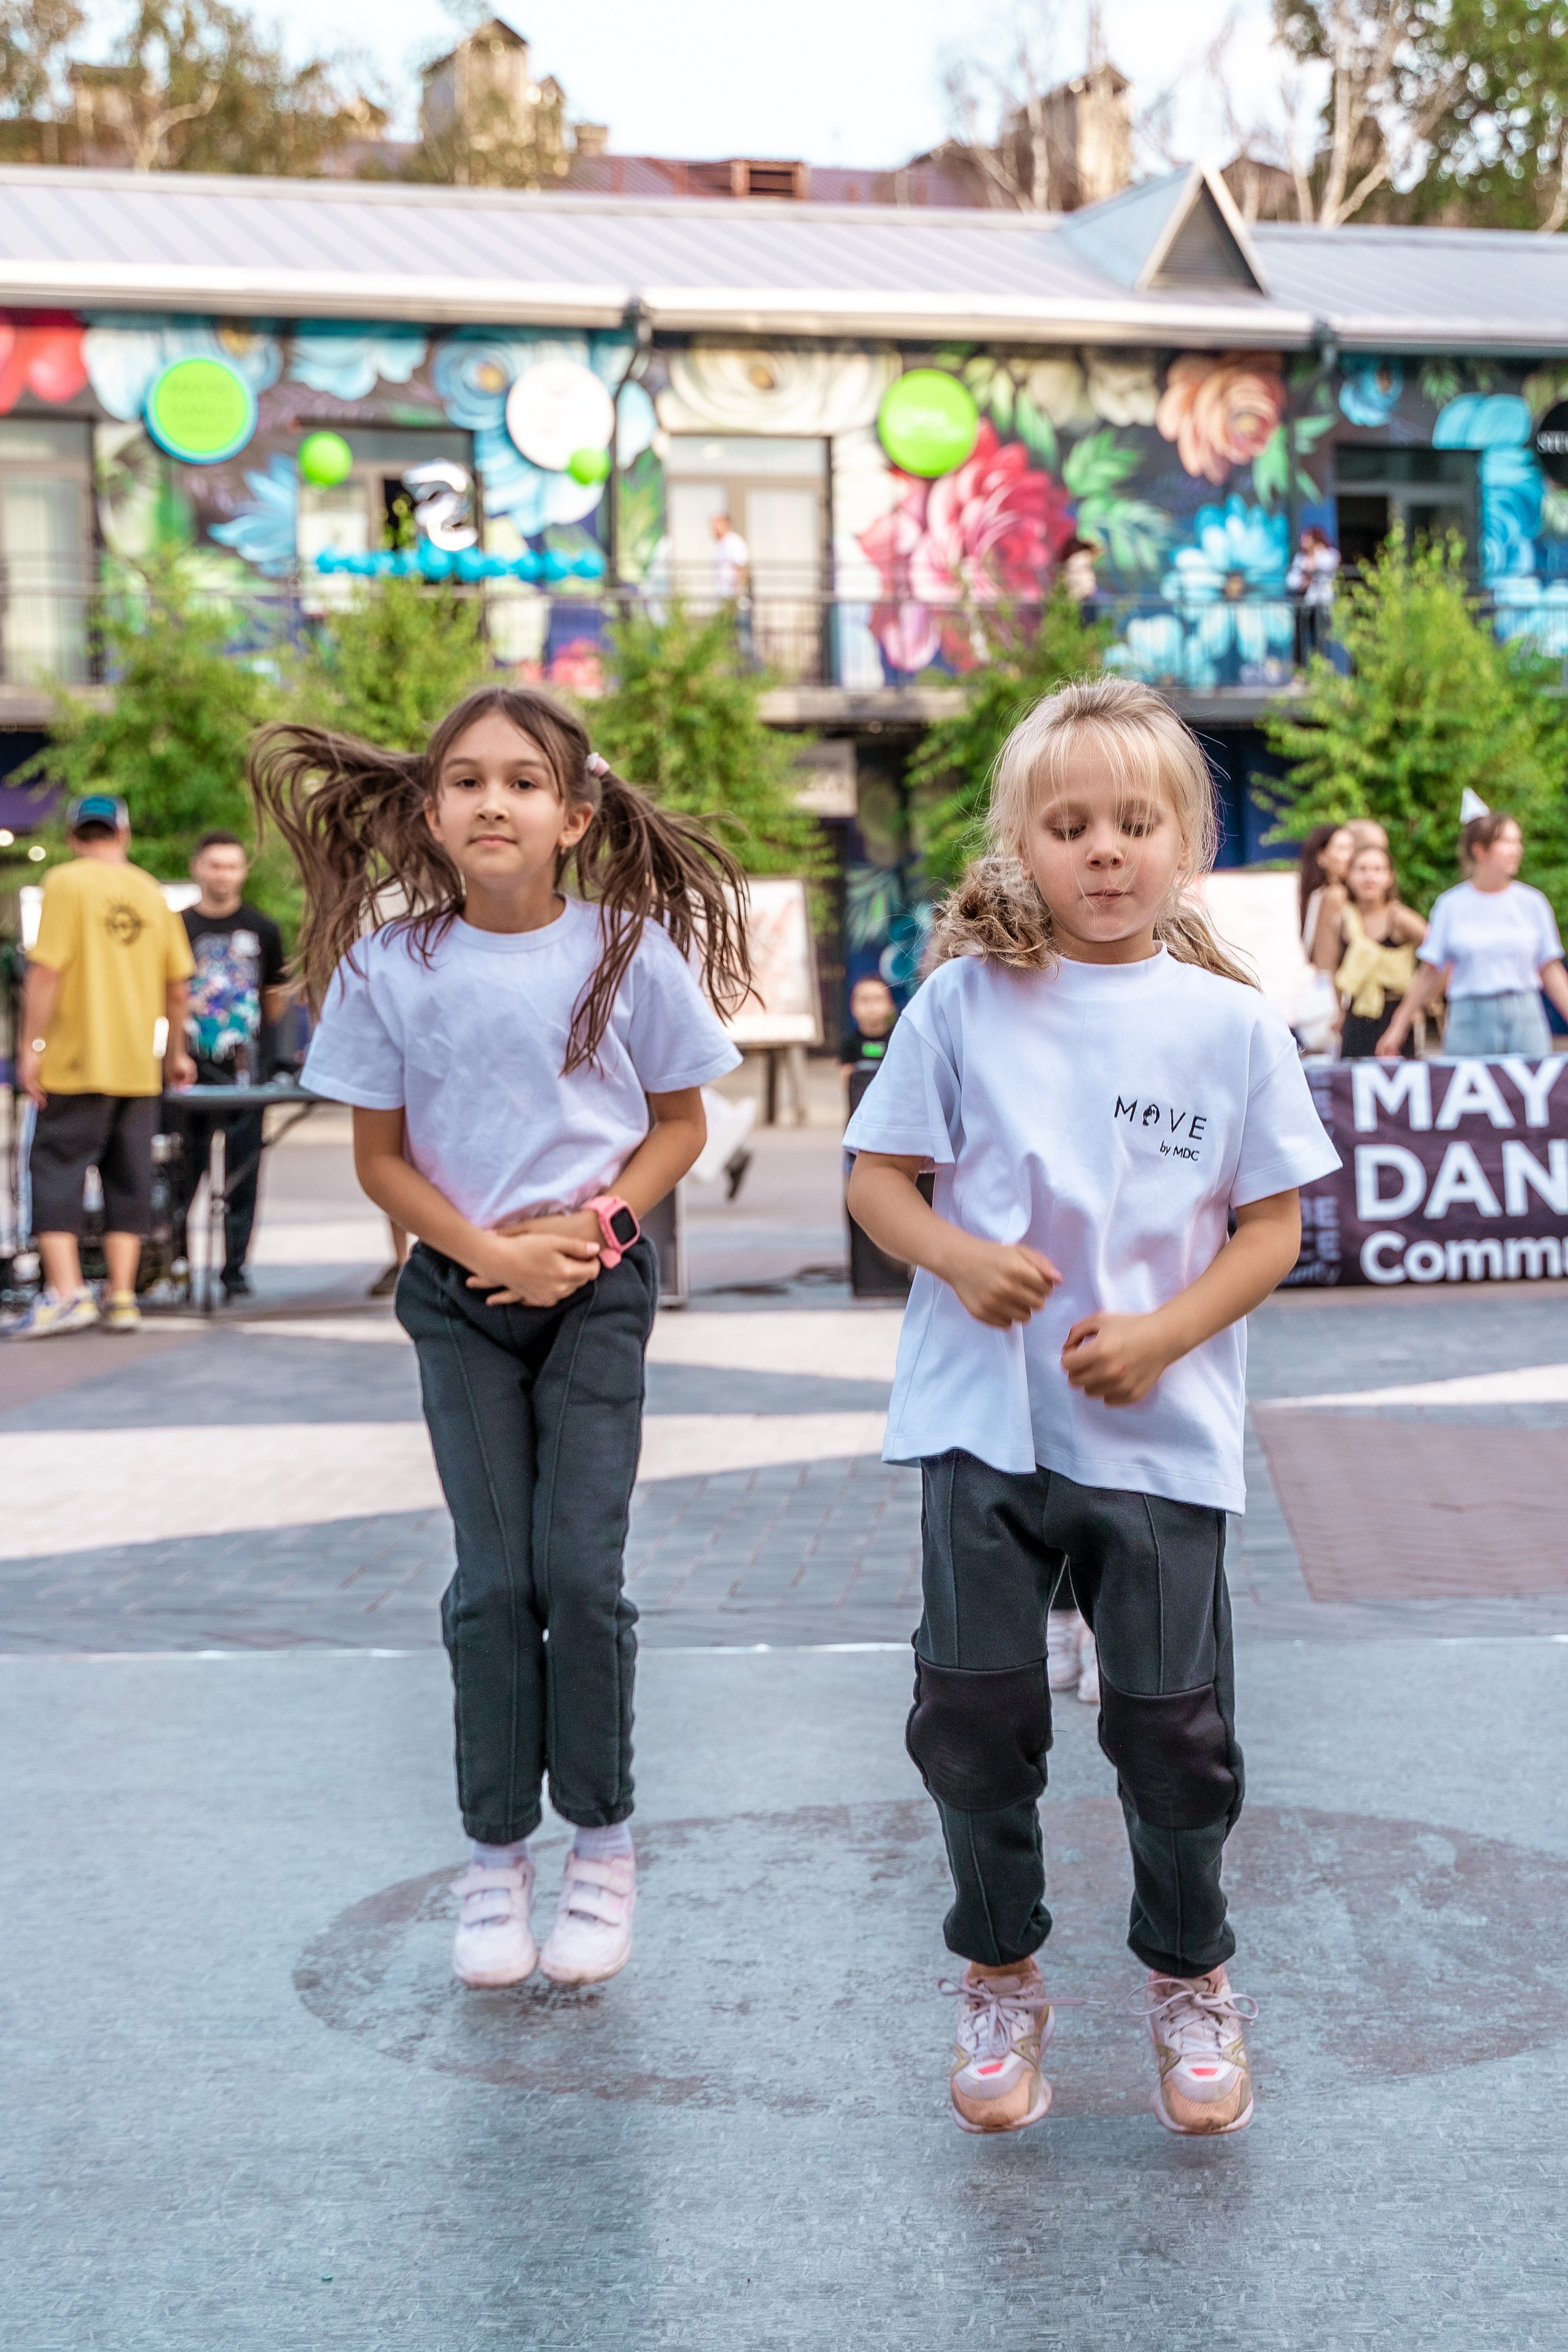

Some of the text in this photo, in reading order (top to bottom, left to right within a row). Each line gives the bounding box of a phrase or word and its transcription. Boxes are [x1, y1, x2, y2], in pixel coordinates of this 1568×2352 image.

[1114, 1095, 1207, 1140] MOVE
[1352, 1059, 1566, 1132] MAY
[1159, 1140, 1200, 1161] by MDC
[1355, 1139, 1568, 1220] DAN
[1360, 1230, 1568, 1284] Comm
